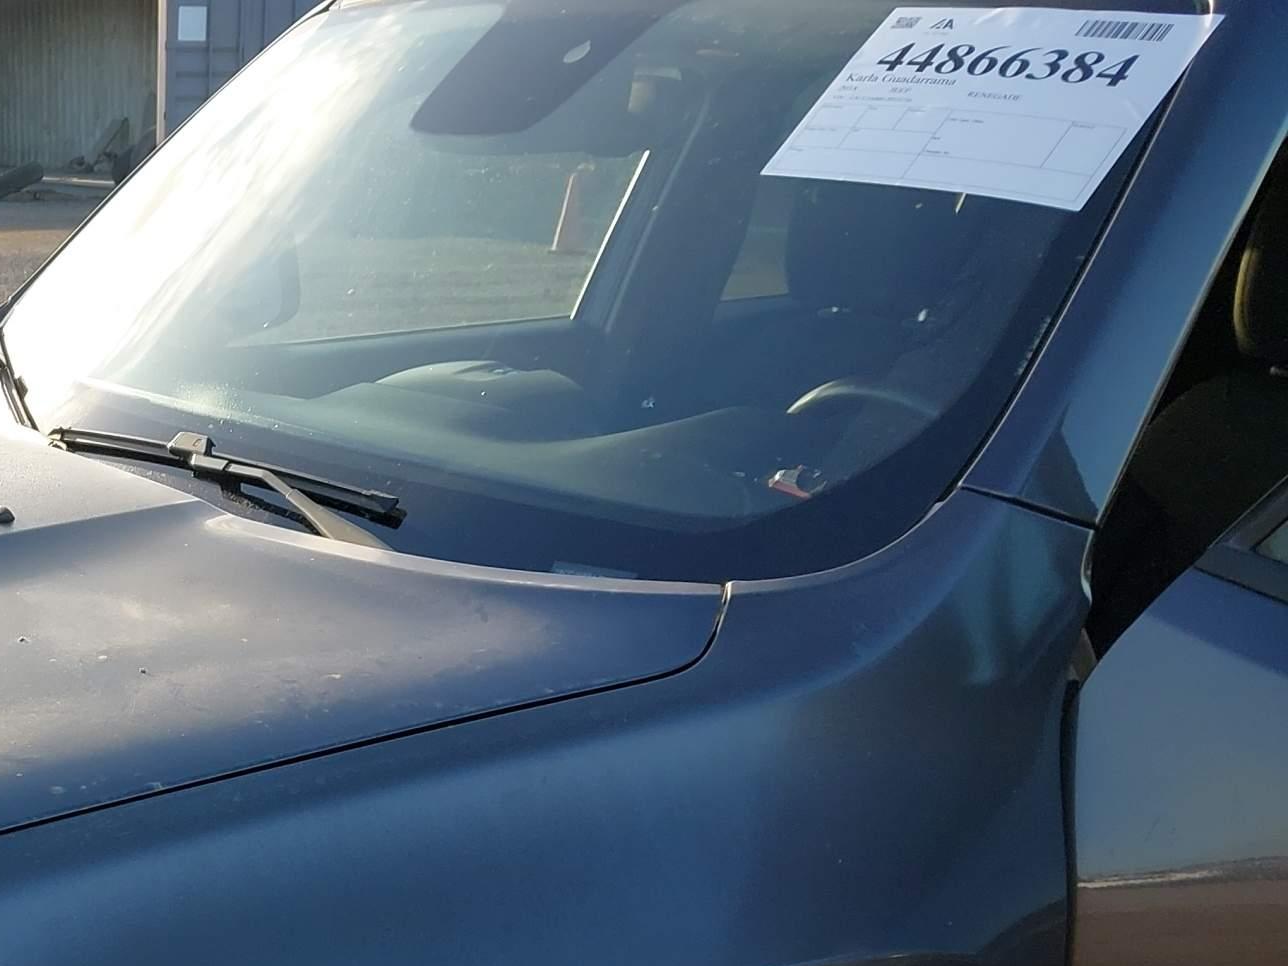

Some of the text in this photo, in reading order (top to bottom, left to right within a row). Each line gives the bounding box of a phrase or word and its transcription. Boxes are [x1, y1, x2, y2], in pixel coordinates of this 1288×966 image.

[878, 42, 1139, 87] 44866384
[845, 73, 957, 87] Karla Guadarrama
